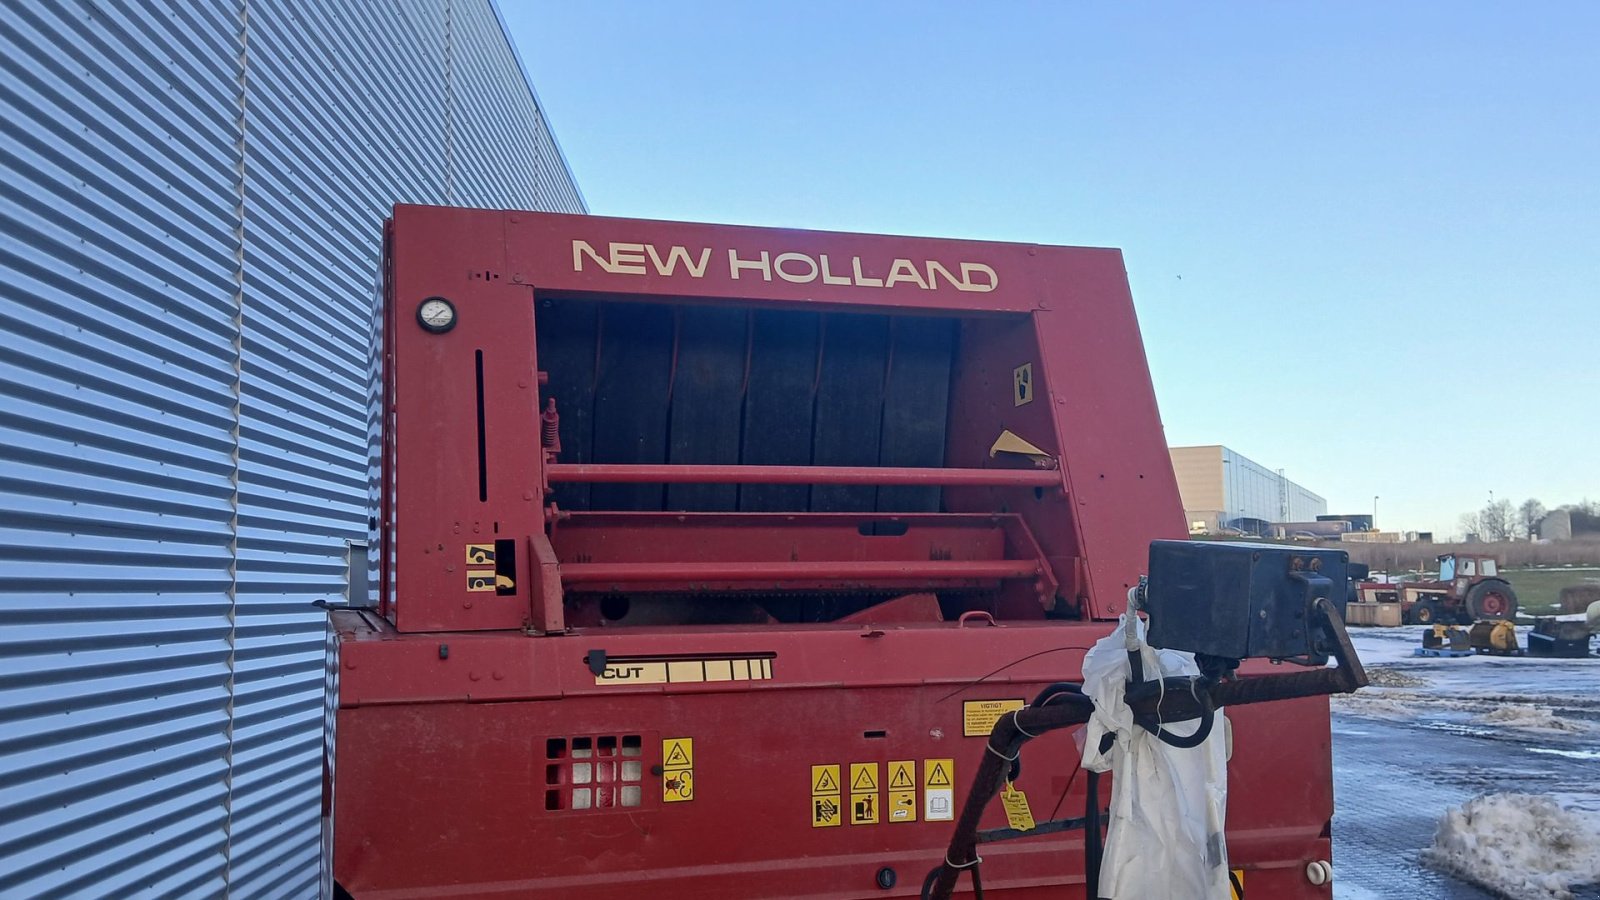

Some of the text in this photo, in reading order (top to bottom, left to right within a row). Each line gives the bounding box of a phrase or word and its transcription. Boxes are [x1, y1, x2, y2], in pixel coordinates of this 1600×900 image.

[572, 239, 998, 293] NEW HOLLAND
[601, 667, 644, 679] CUT
